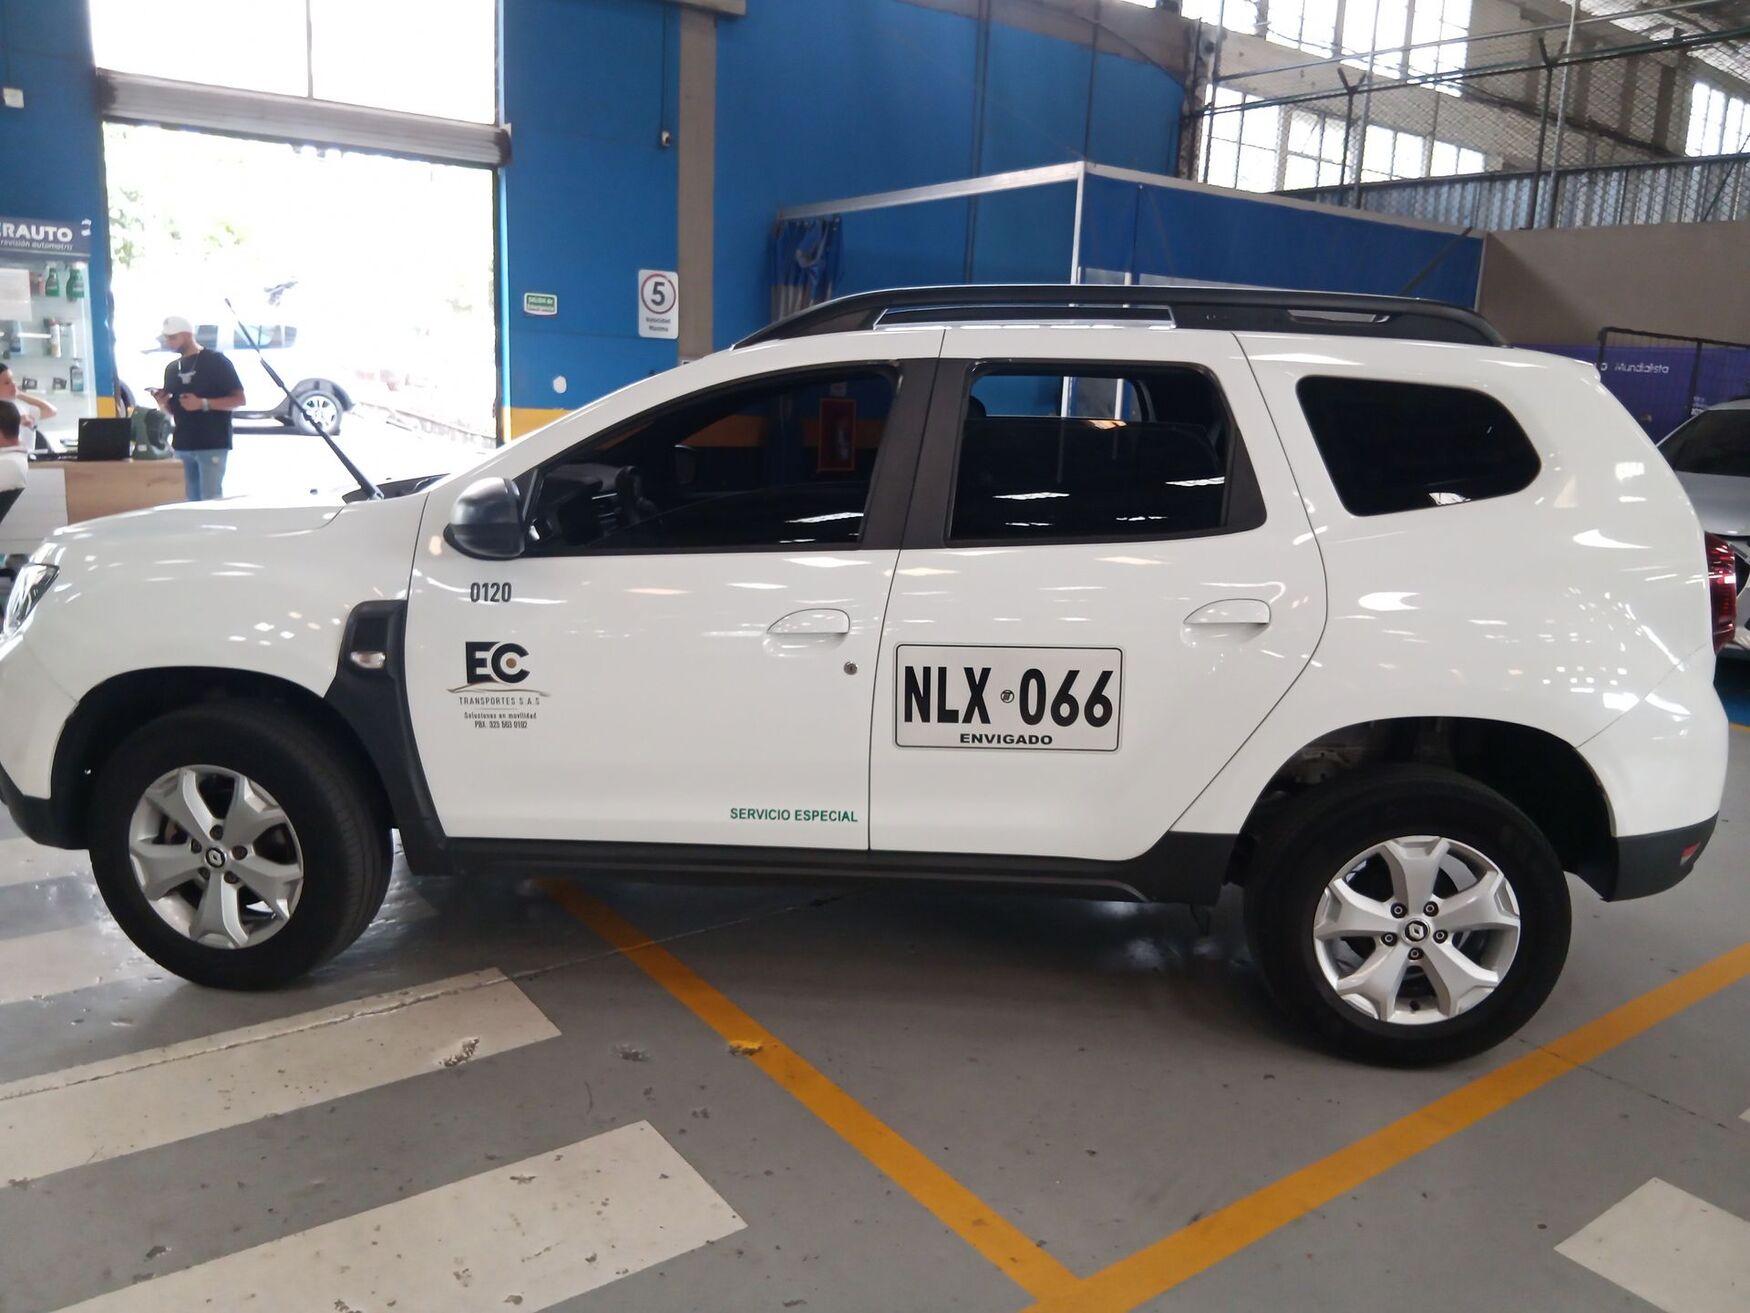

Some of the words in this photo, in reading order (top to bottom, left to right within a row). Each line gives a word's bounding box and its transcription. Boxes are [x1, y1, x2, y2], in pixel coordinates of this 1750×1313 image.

[0, 222, 73, 243] RAUTO
[651, 281, 666, 306] 5
[470, 582, 512, 602] 0120
[465, 641, 531, 684] EC
[459, 697, 516, 705] TRANSPORTES
[904, 666, 992, 724] NLX
[1019, 668, 1113, 727] 066
[959, 733, 1053, 745] ENVIGADO
[730, 808, 791, 820] SERVICIO
[794, 810, 858, 822] ESPECIAL
